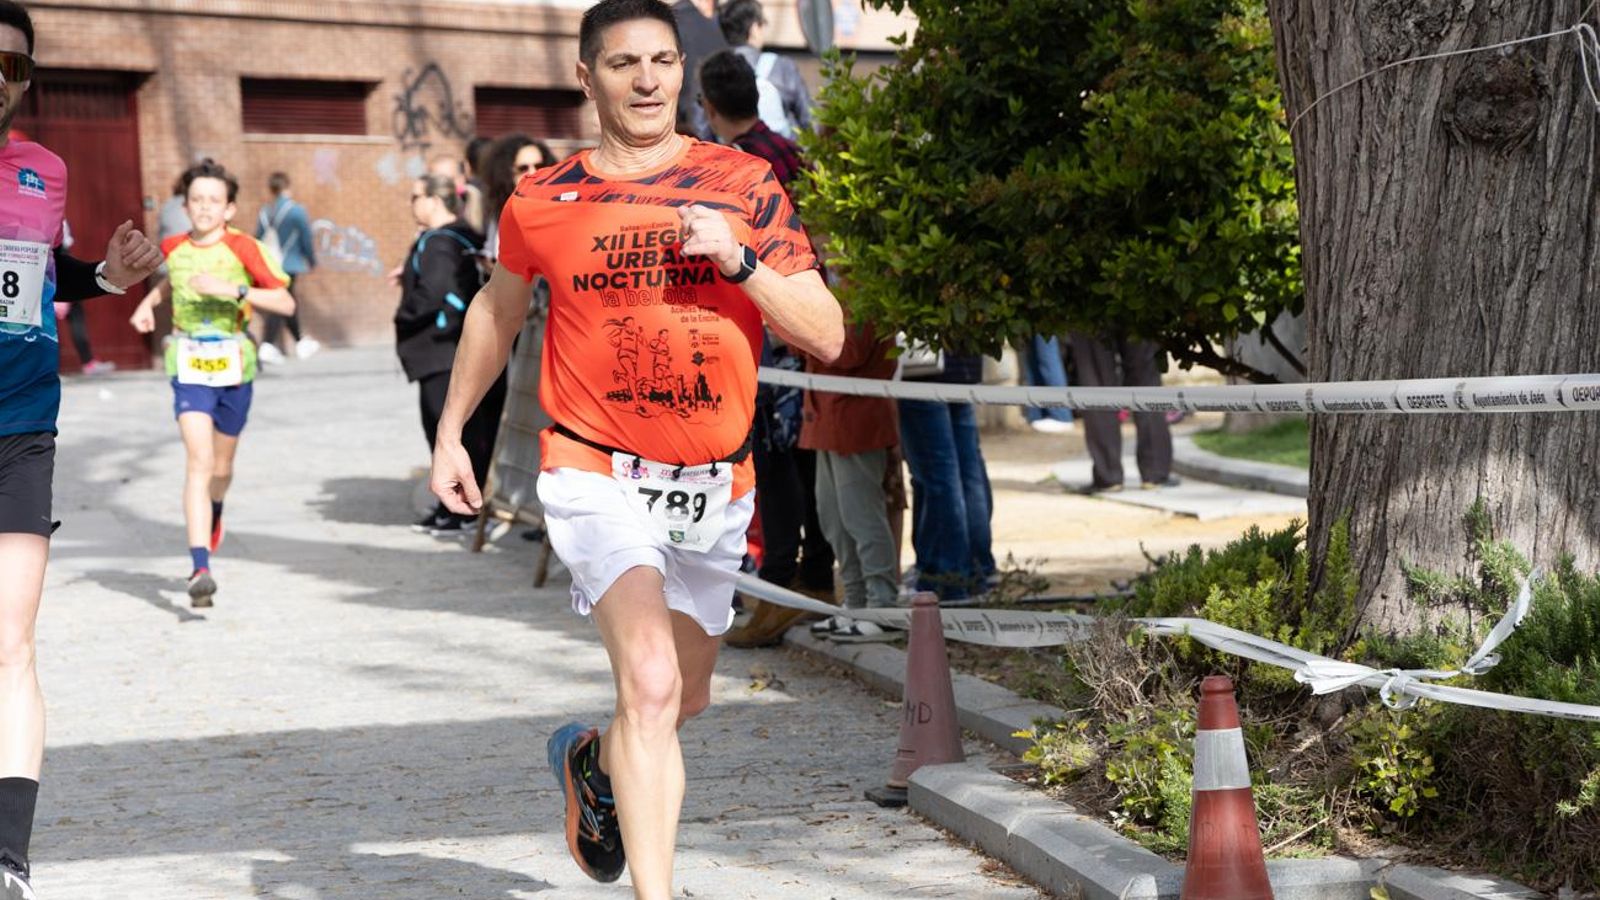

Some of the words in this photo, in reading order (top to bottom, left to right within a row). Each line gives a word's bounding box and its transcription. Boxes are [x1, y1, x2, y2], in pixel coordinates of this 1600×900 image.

[591, 233, 625, 252] XII
[632, 229, 691, 249] LEGU
[2, 271, 19, 298] 8
[573, 266, 716, 292] NOCTURNA
[600, 286, 621, 308] la
[624, 286, 698, 307] bellota
[1406, 394, 1448, 409] DEPORTES
[1472, 392, 1519, 408] Ayuntamiento
[1518, 389, 1529, 405] de
[637, 486, 707, 523] 789
